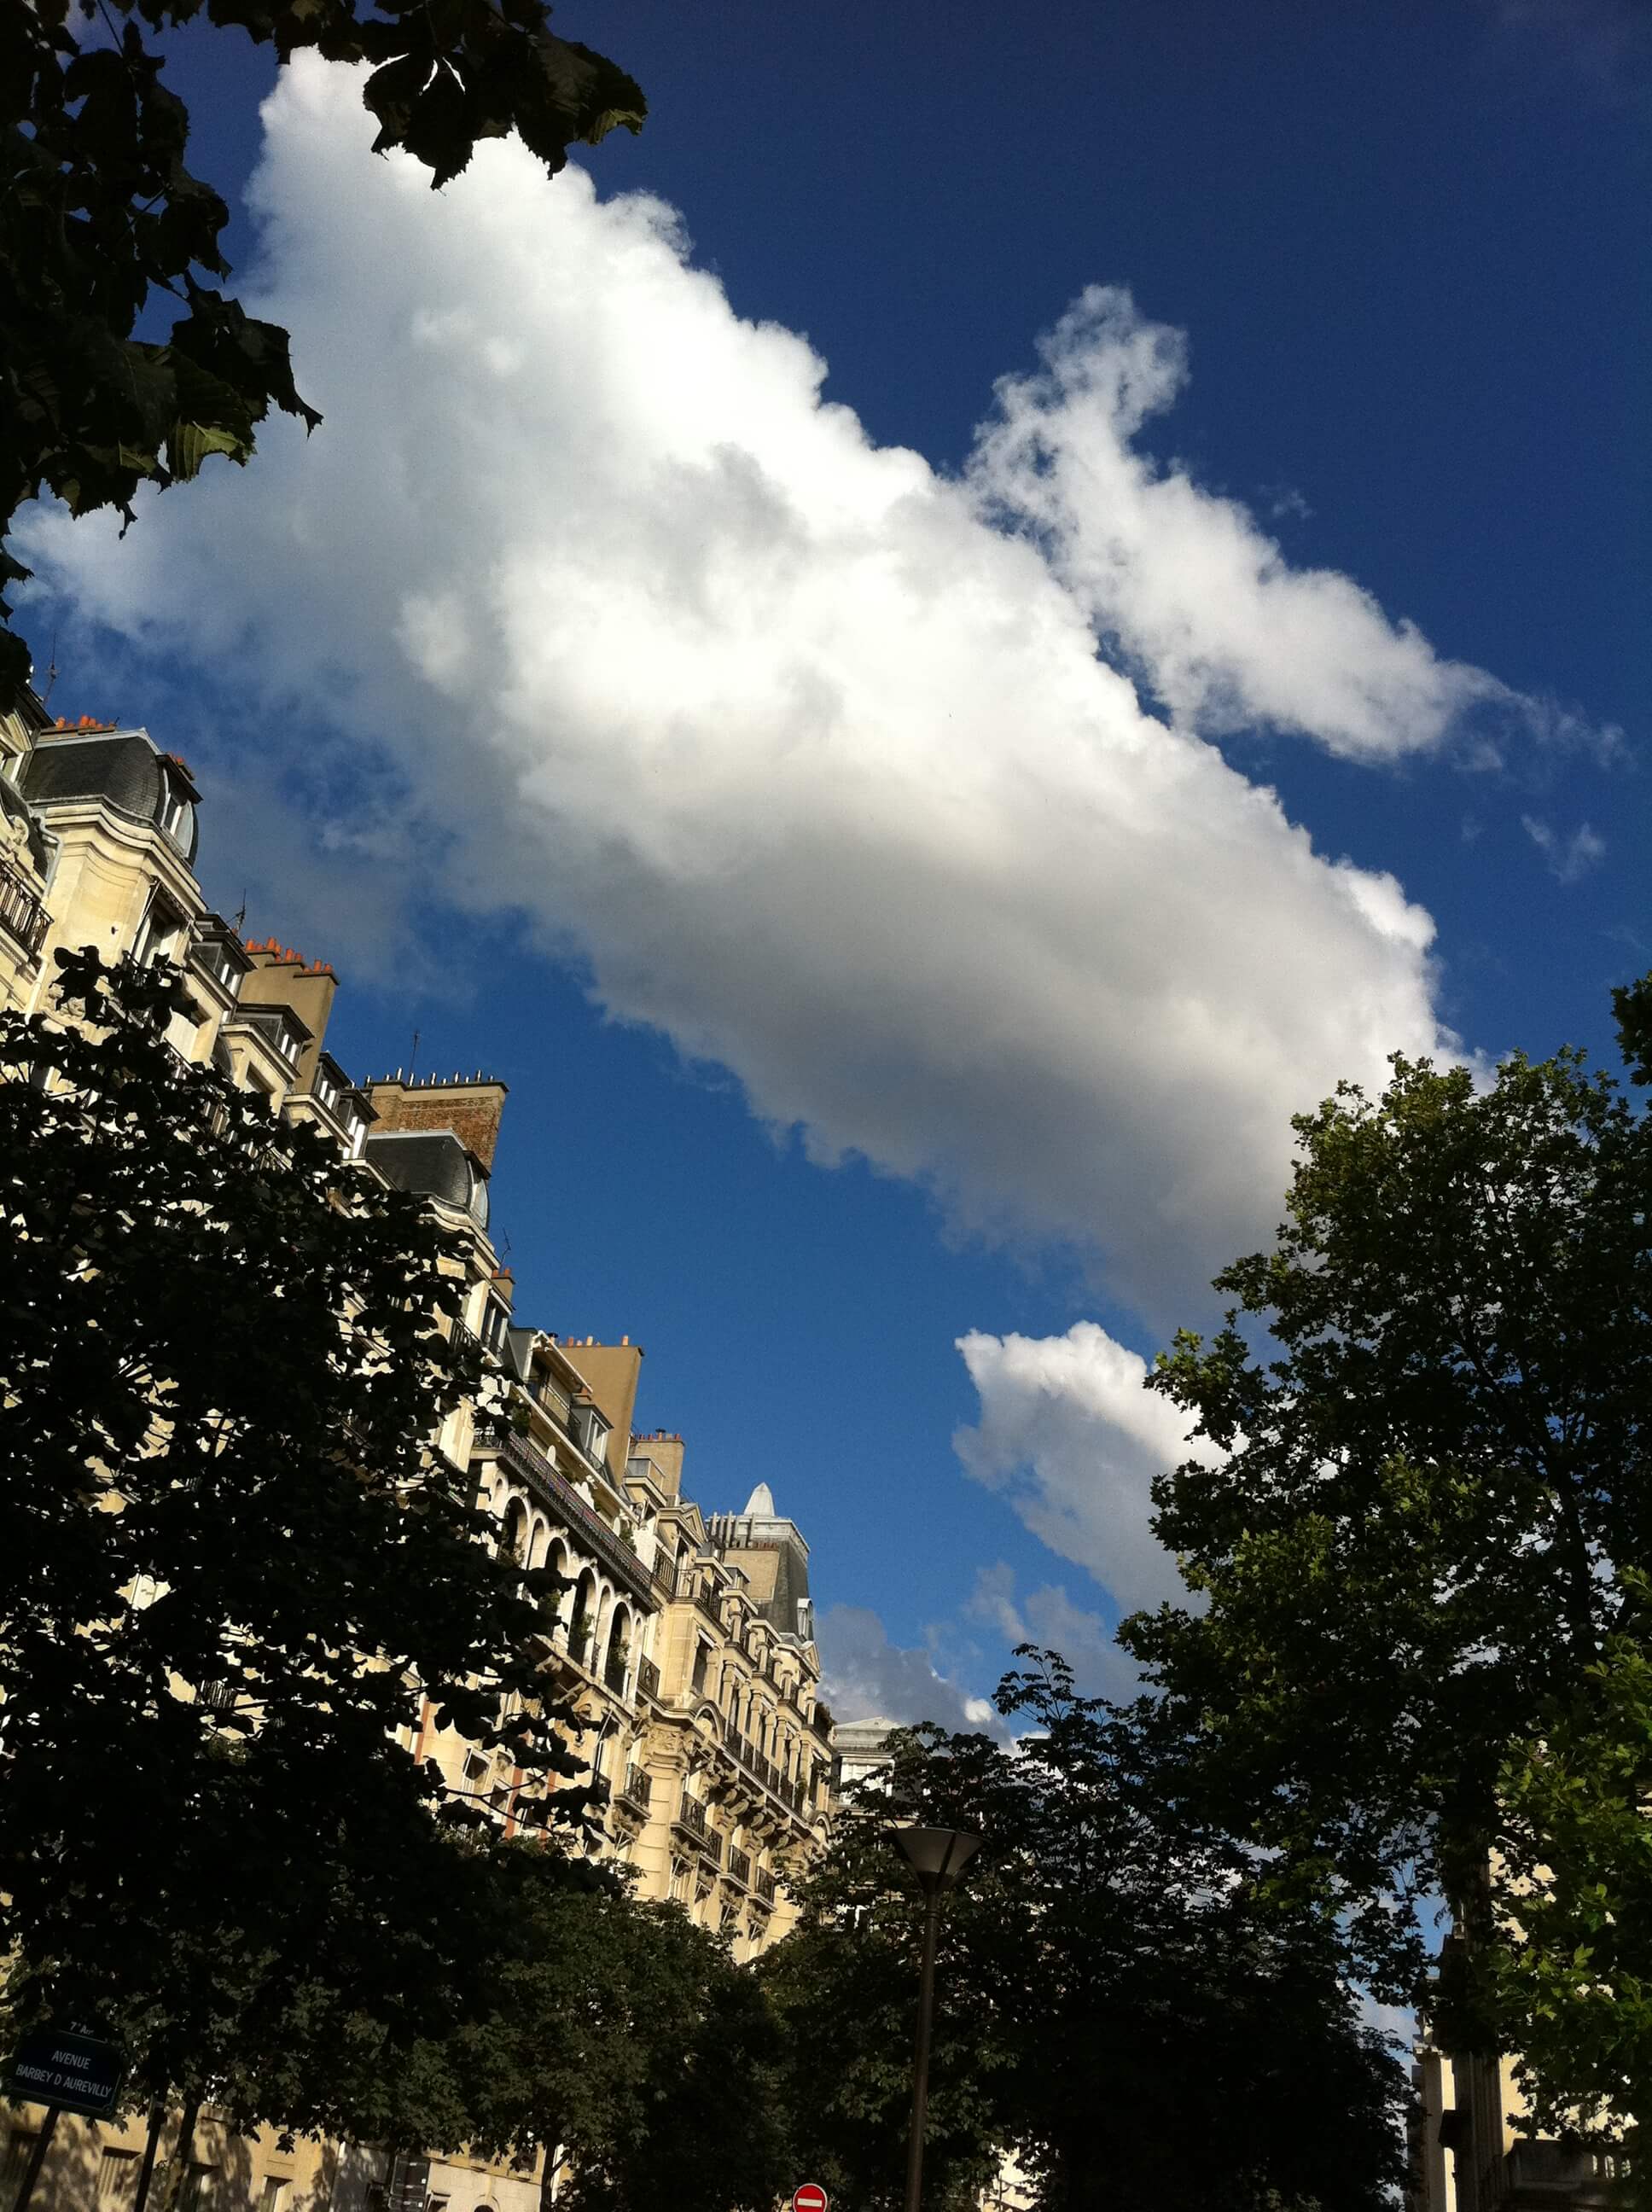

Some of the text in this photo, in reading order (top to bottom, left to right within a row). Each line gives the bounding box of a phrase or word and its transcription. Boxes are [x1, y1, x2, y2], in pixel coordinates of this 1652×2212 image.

[51, 2050, 91, 2069] AVENUE
[15, 2064, 54, 2083] BARBEY
[63, 2075, 112, 2098] AUREVILLY
